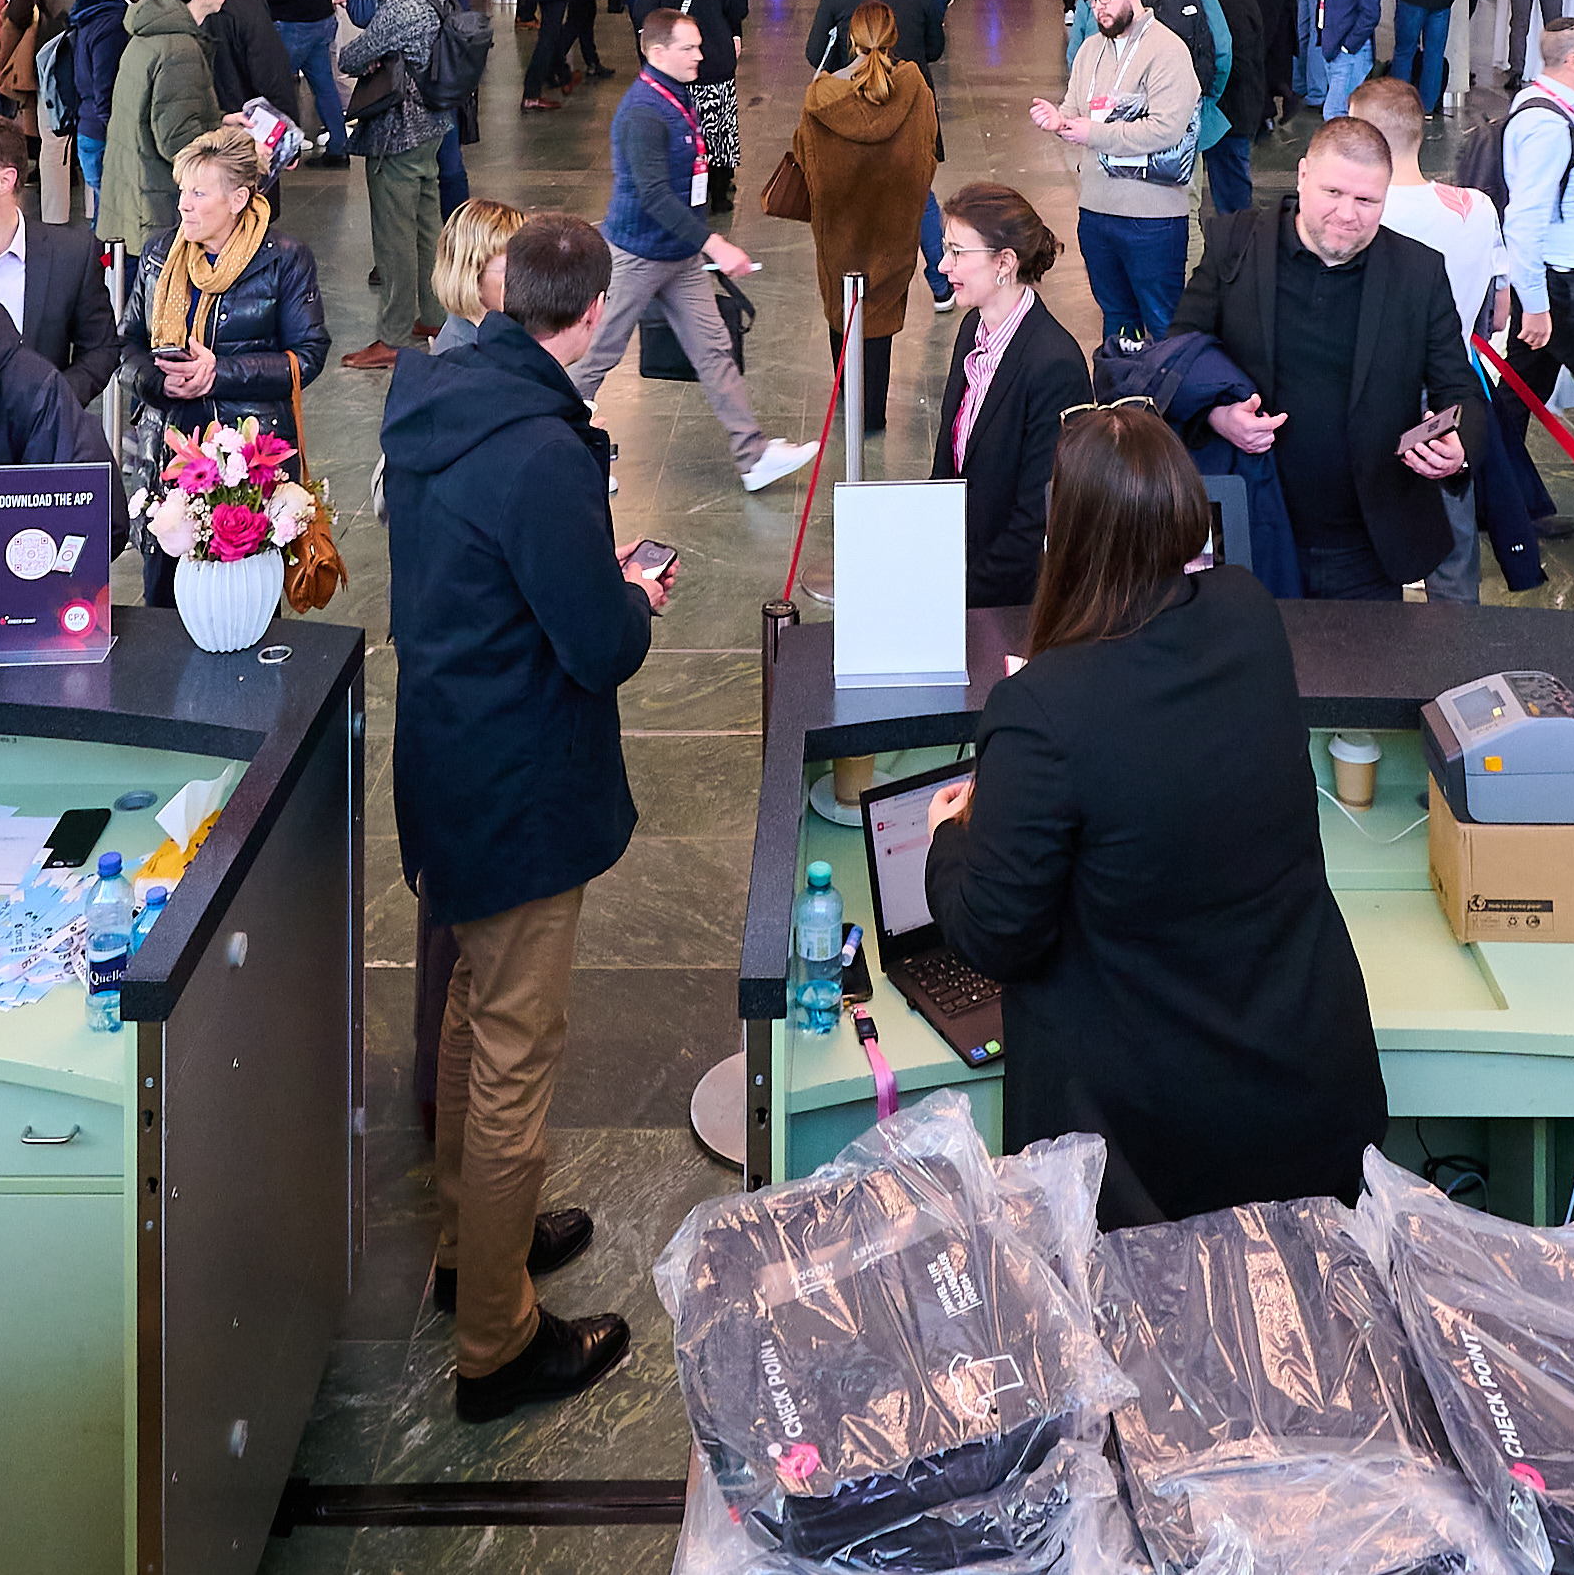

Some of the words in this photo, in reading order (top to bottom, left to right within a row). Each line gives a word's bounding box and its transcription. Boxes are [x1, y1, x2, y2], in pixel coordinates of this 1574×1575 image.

[54, 492, 72, 506] THE
[74, 492, 93, 505] APP
[68, 613, 85, 622] CPX
[927, 1262, 943, 1283] LIFE
[1461, 1329, 1499, 1389] POINT
[771, 1386, 803, 1438] CHECK
[1487, 1391, 1525, 1458] CHECK
